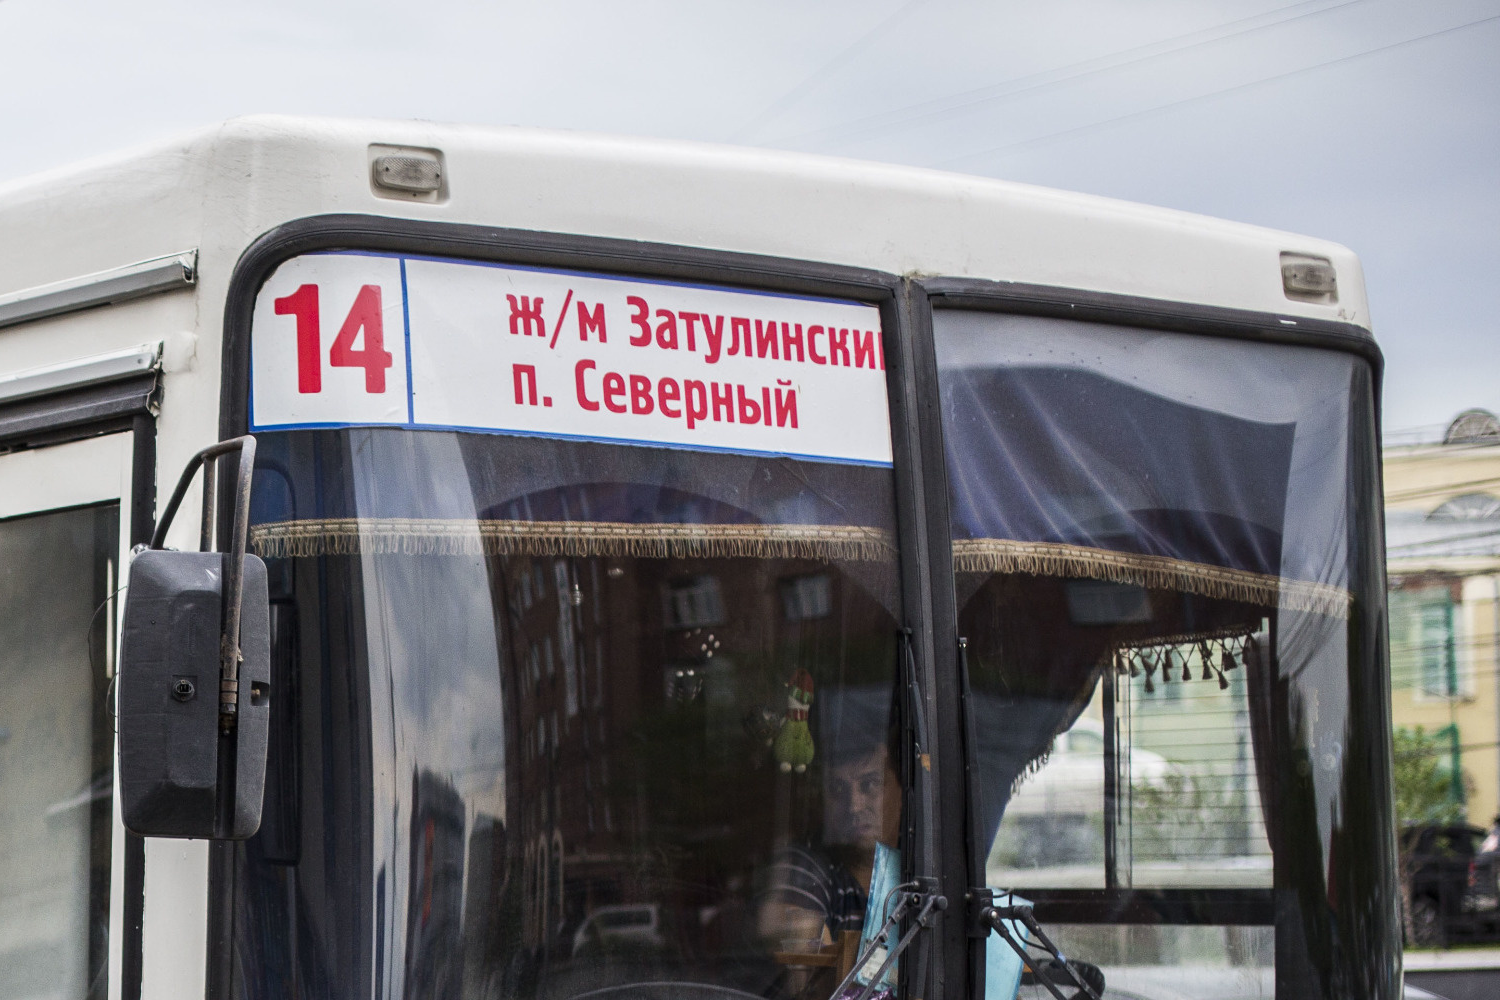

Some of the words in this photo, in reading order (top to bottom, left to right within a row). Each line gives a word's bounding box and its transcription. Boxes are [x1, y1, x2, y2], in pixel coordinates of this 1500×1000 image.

[274, 283, 393, 395] 14
[506, 288, 608, 350] ж/м
[512, 362, 554, 408] п.
[574, 357, 800, 430] Северный
